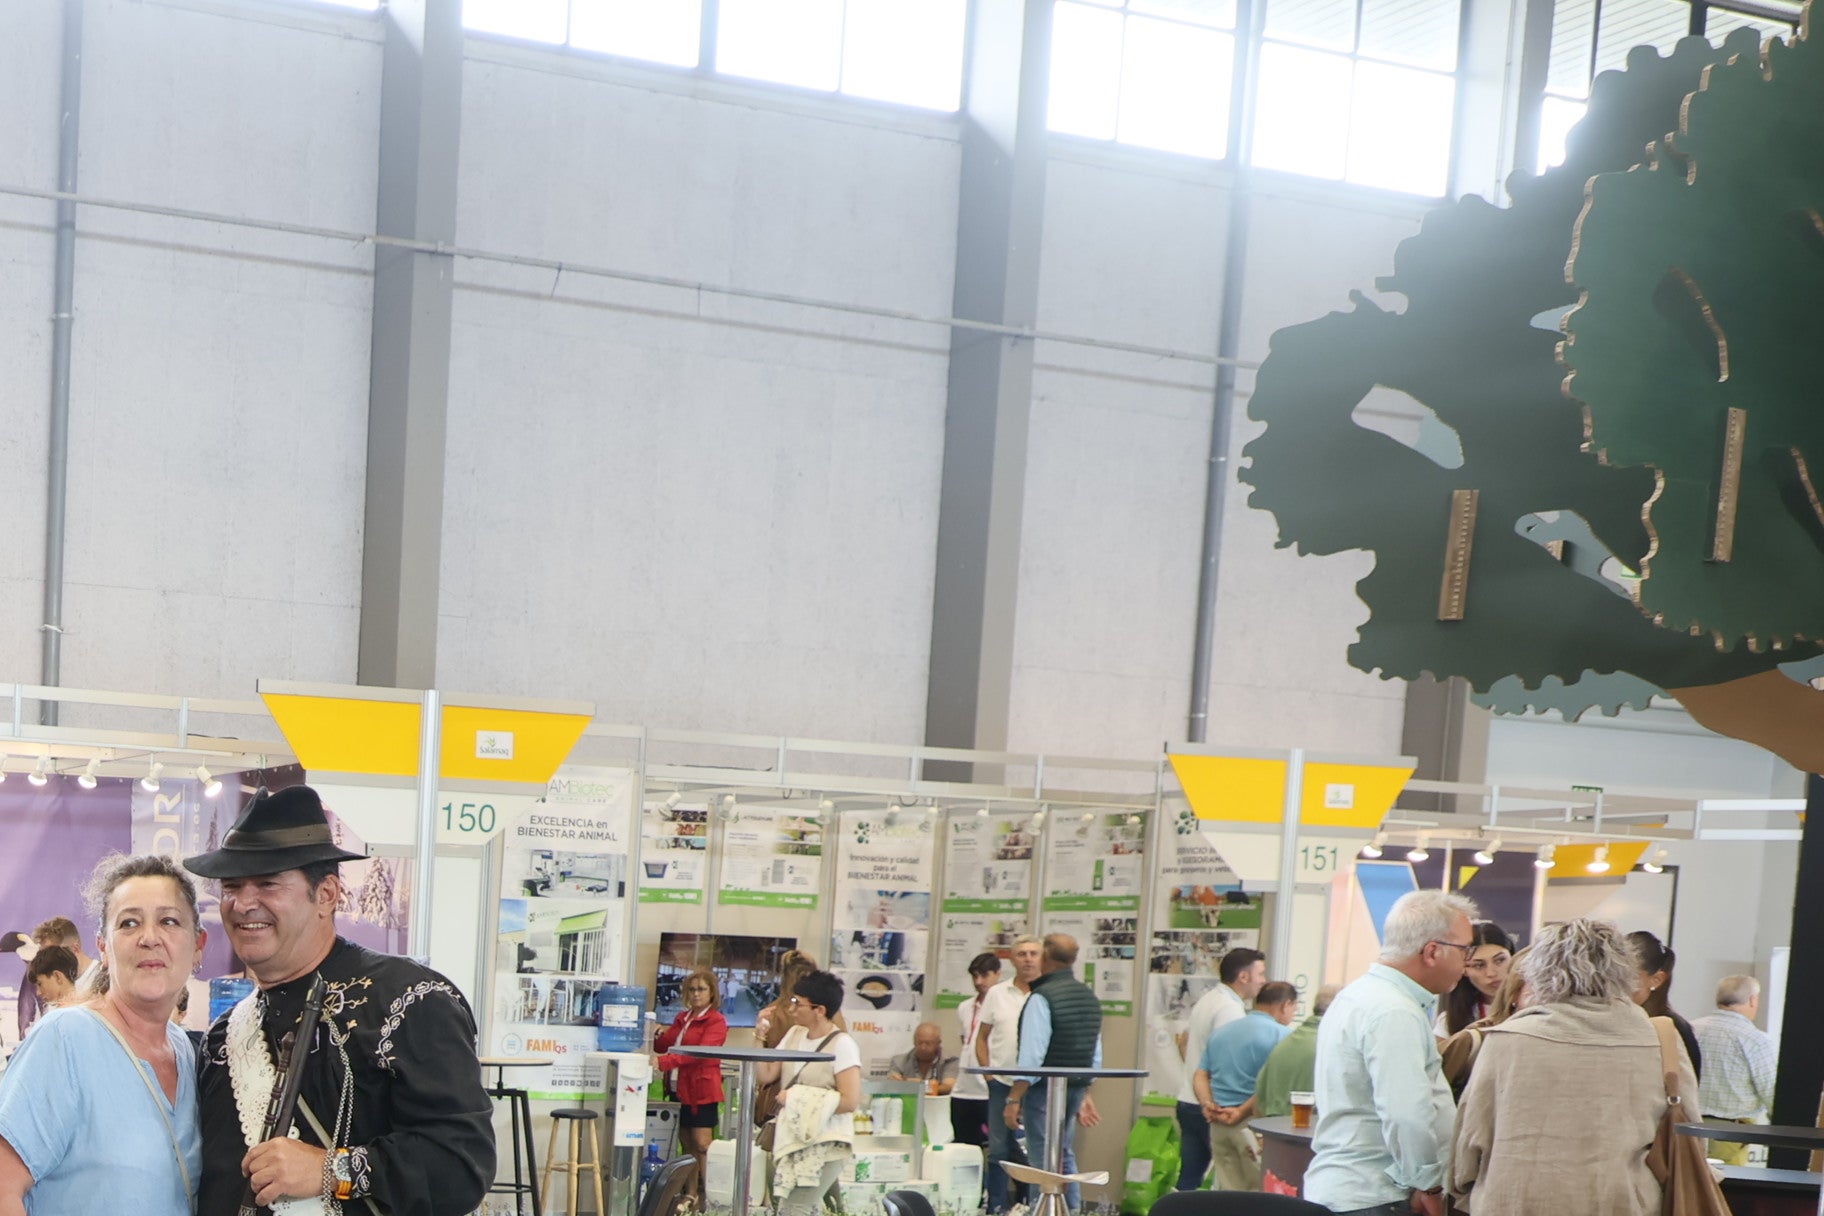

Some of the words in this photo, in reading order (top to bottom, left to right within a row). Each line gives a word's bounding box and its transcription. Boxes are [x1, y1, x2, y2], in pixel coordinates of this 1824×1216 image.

[442, 802, 496, 833] 150
[530, 815, 593, 828] EXCELENCIA
[596, 821, 608, 829] en
[517, 826, 575, 839] BIENESTAR
[576, 830, 618, 842] ANIMAL
[1301, 846, 1338, 871] 151
[848, 871, 889, 880] BIENESTAR
[892, 874, 918, 882] ANIMAL
